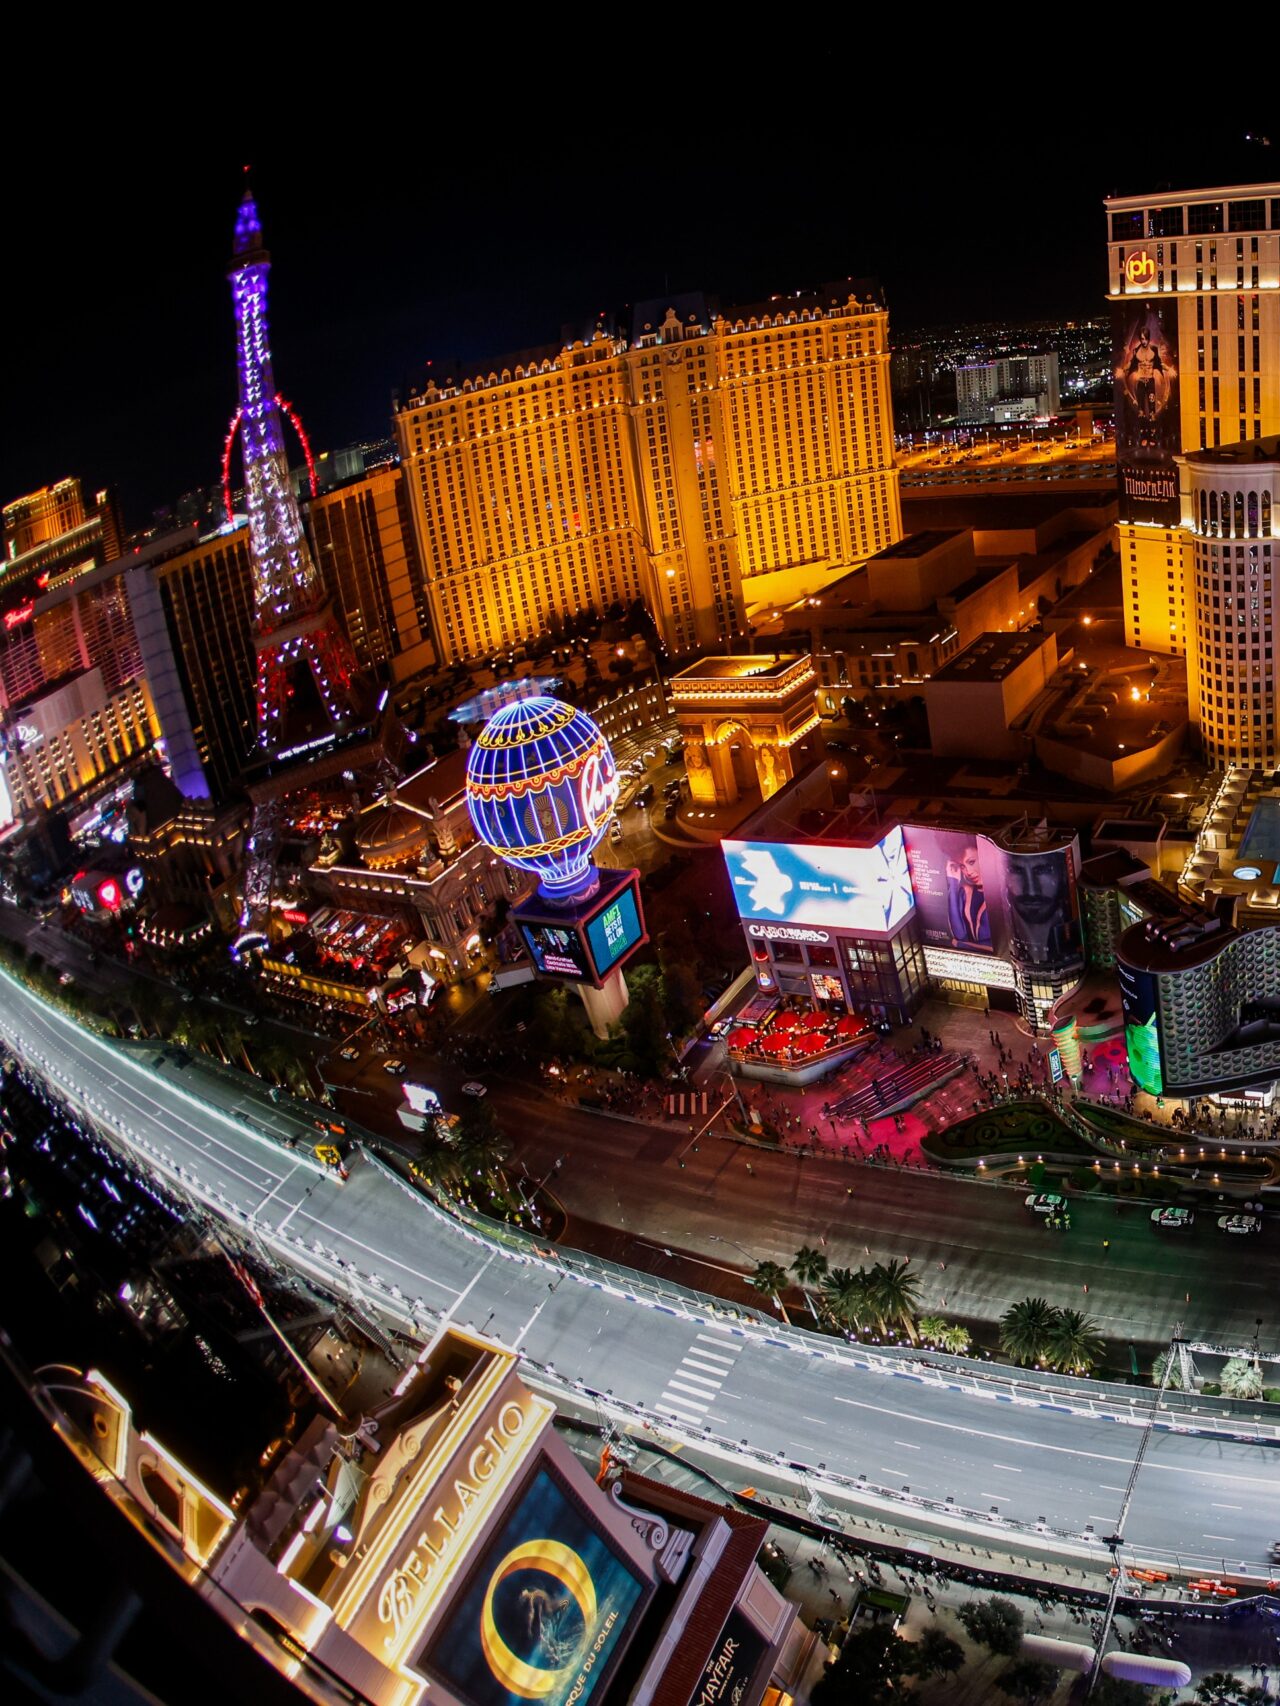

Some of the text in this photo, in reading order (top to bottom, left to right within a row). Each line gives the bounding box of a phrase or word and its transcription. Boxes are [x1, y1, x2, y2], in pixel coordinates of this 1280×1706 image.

[1129, 252, 1155, 280] ph
[1125, 477, 1176, 498] MINDFREAK
[378, 1401, 525, 1648] BELLAGIO
[564, 1610, 619, 1706] RQUE DU SOLEIL
[695, 1637, 740, 1706] MAYFAIR
[706, 1660, 715, 1674] THE
